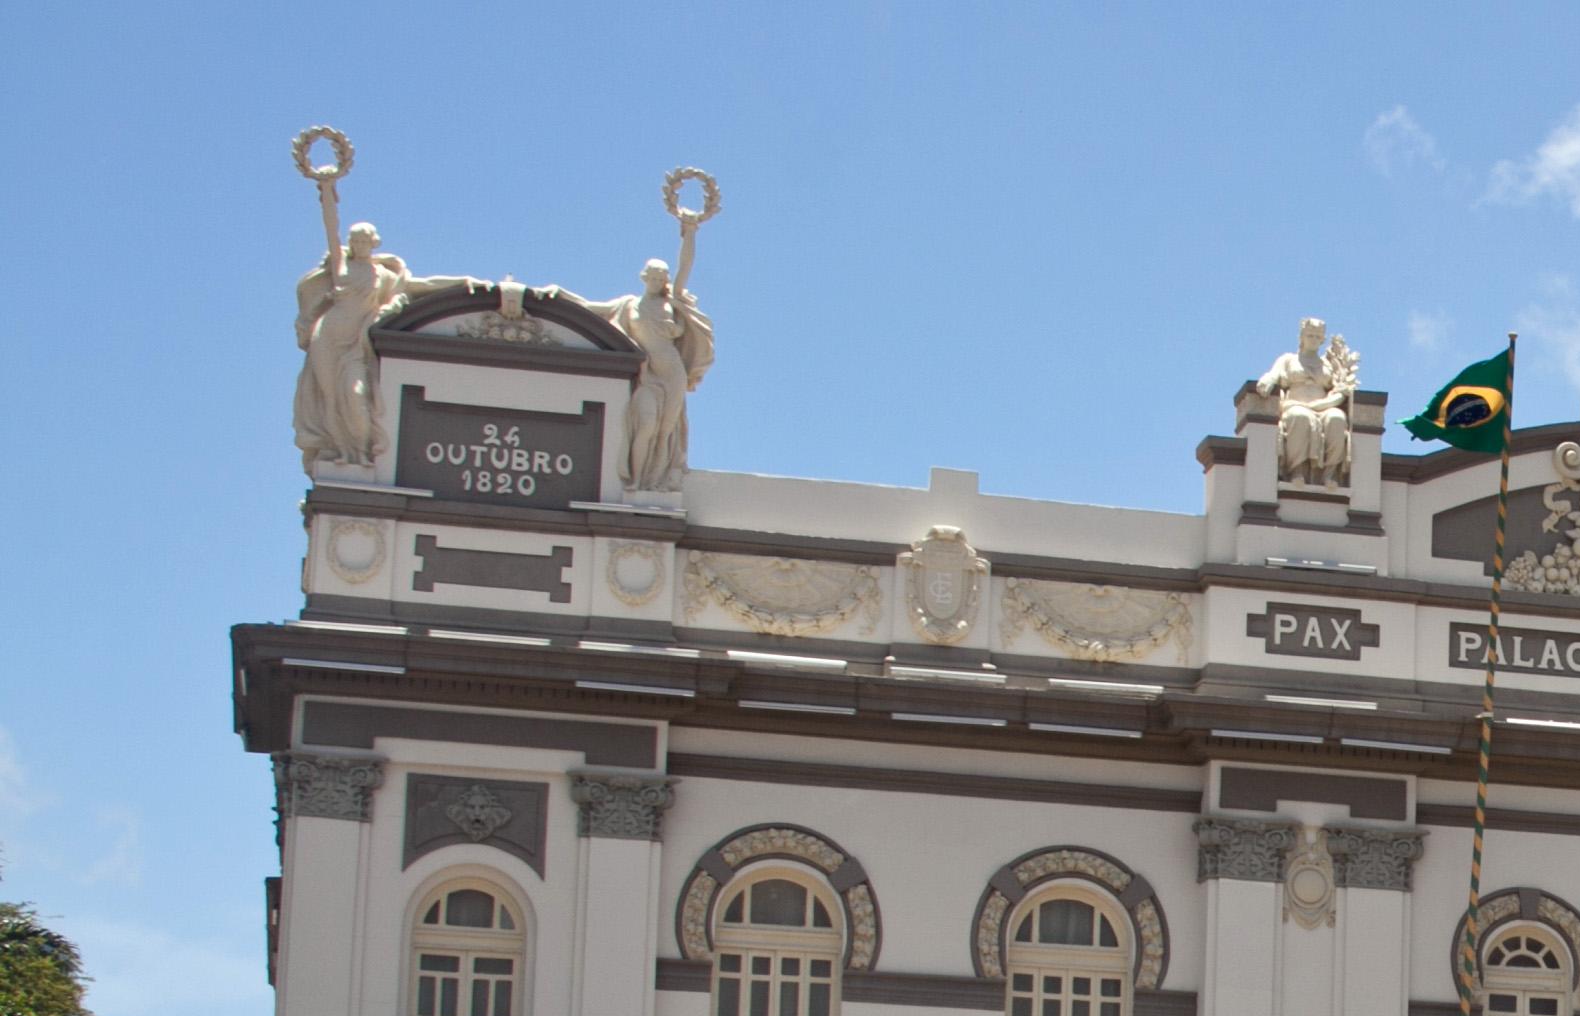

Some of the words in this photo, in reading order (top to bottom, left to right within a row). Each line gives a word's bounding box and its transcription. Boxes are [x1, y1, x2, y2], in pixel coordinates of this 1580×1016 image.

[483, 423, 520, 448] 24
[425, 442, 573, 475] OUTUBRO
[461, 469, 536, 496] 1820
[1274, 613, 1353, 651] PAX
